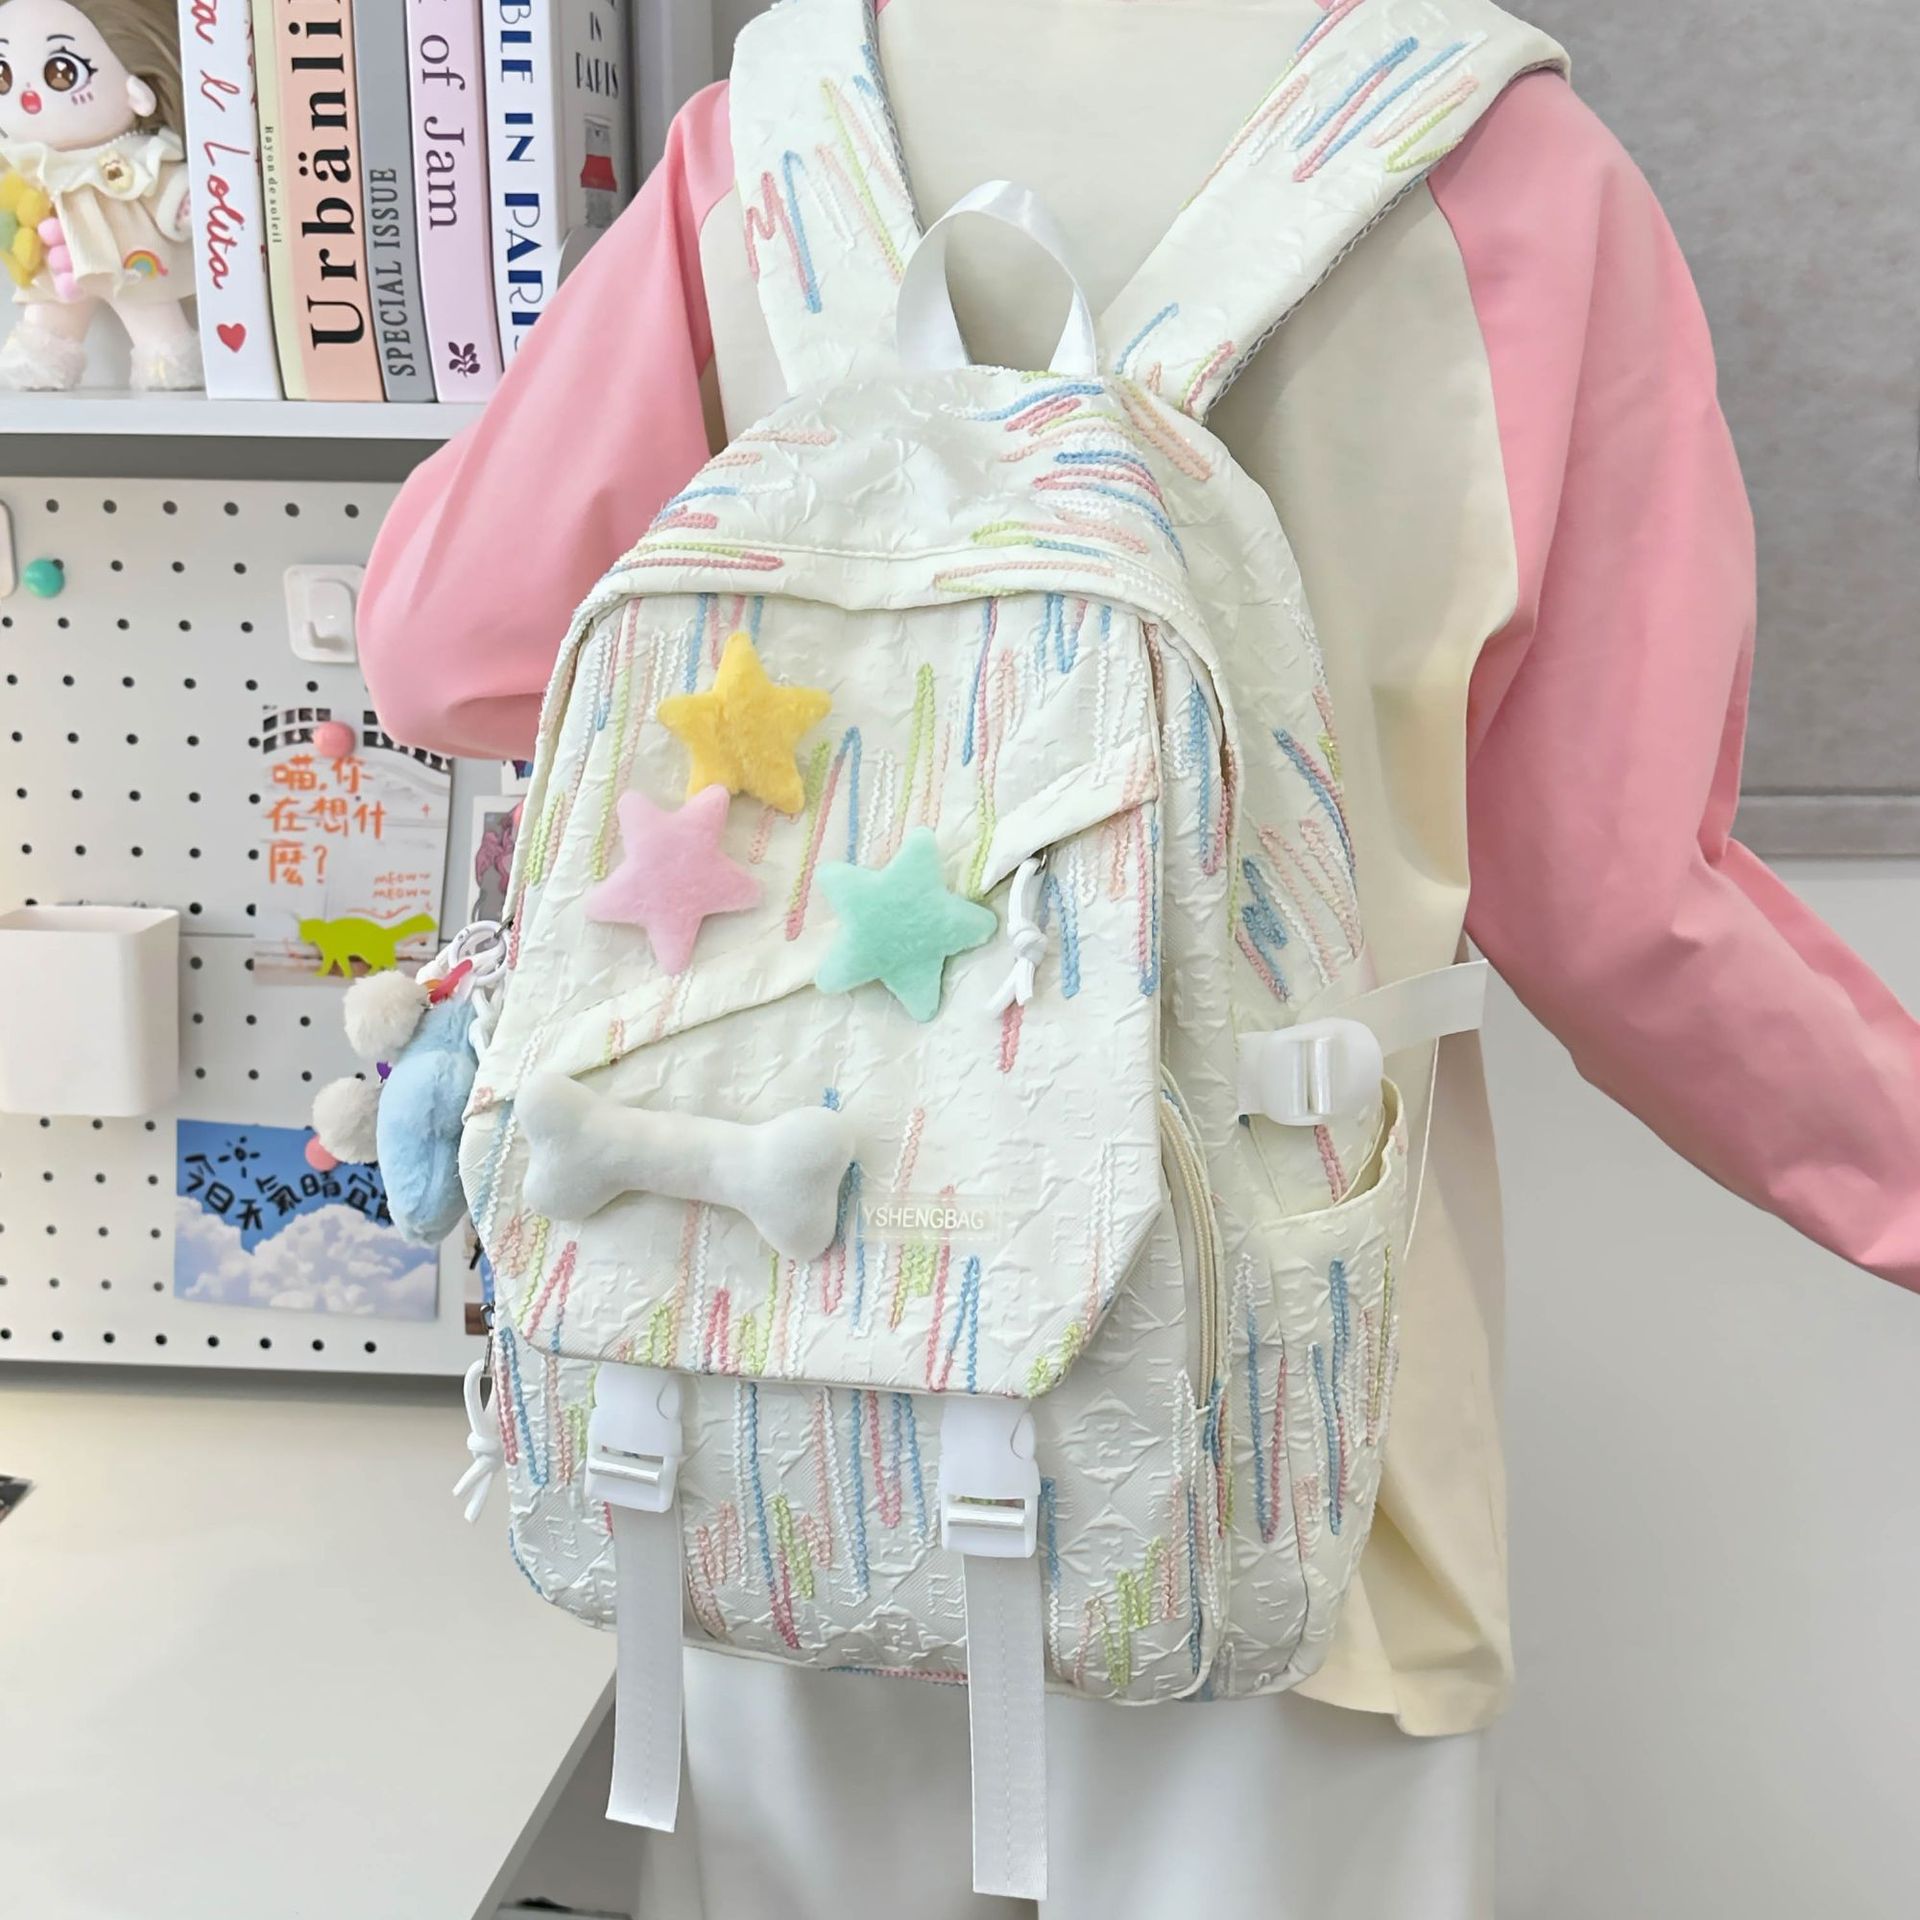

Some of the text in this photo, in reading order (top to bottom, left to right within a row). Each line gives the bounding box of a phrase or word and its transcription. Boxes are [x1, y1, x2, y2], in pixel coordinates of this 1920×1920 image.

[264, 125, 282, 244] Rayon de soleil
[287, 0, 365, 350] Urbänli
[419, 33, 466, 231] of Jam
[504, 112, 536, 163] IN
[203, 141, 251, 290] Lolita
[369, 167, 417, 377] SPECIAL ISSUE
[504, 192, 544, 353] PARI
[264, 796, 388, 840] 在想什
[863, 1206, 985, 1230] YSHENGBAG
